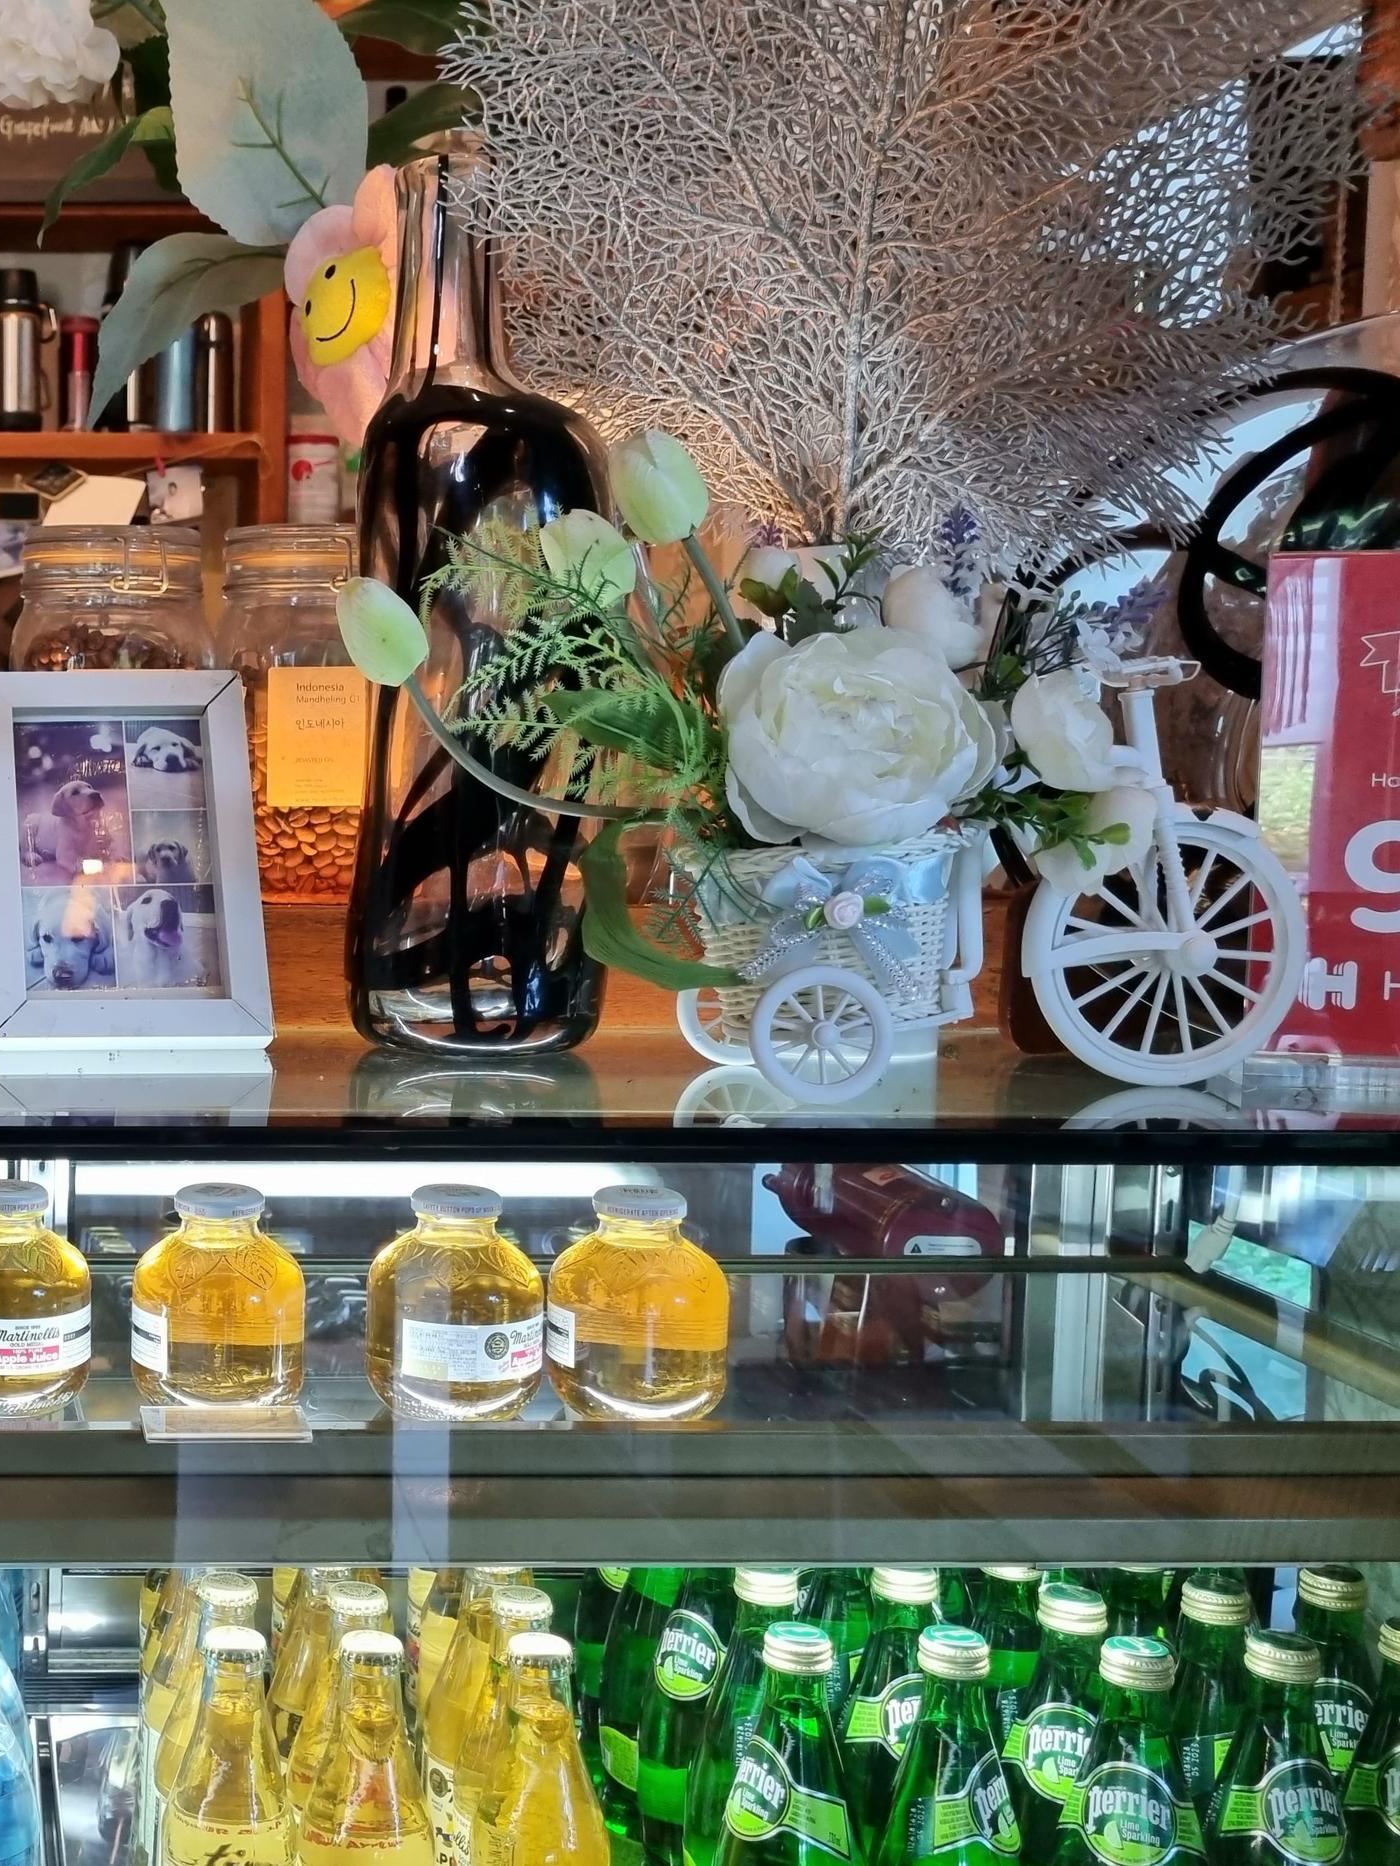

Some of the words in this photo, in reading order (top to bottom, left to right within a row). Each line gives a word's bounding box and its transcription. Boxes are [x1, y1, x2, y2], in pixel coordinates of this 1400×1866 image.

[296, 683, 344, 692] Indonesia
[295, 718, 345, 731] 인도네시아
[30, 1352, 58, 1364] Juice
[656, 1627, 717, 1671] perrier
[1314, 1699, 1370, 1733] errie
[1330, 1729, 1349, 1739] Lime
[1025, 1724, 1090, 1770] perri
[1058, 1755, 1076, 1767] Lime
[736, 1756, 786, 1809] errier
[741, 1799, 769, 1821] Sparkling
[1086, 1785, 1171, 1834] perrier
[1267, 1780, 1339, 1839] perrier
[1120, 1819, 1140, 1830] Lime
[1122, 1829, 1160, 1847] Sparkling
